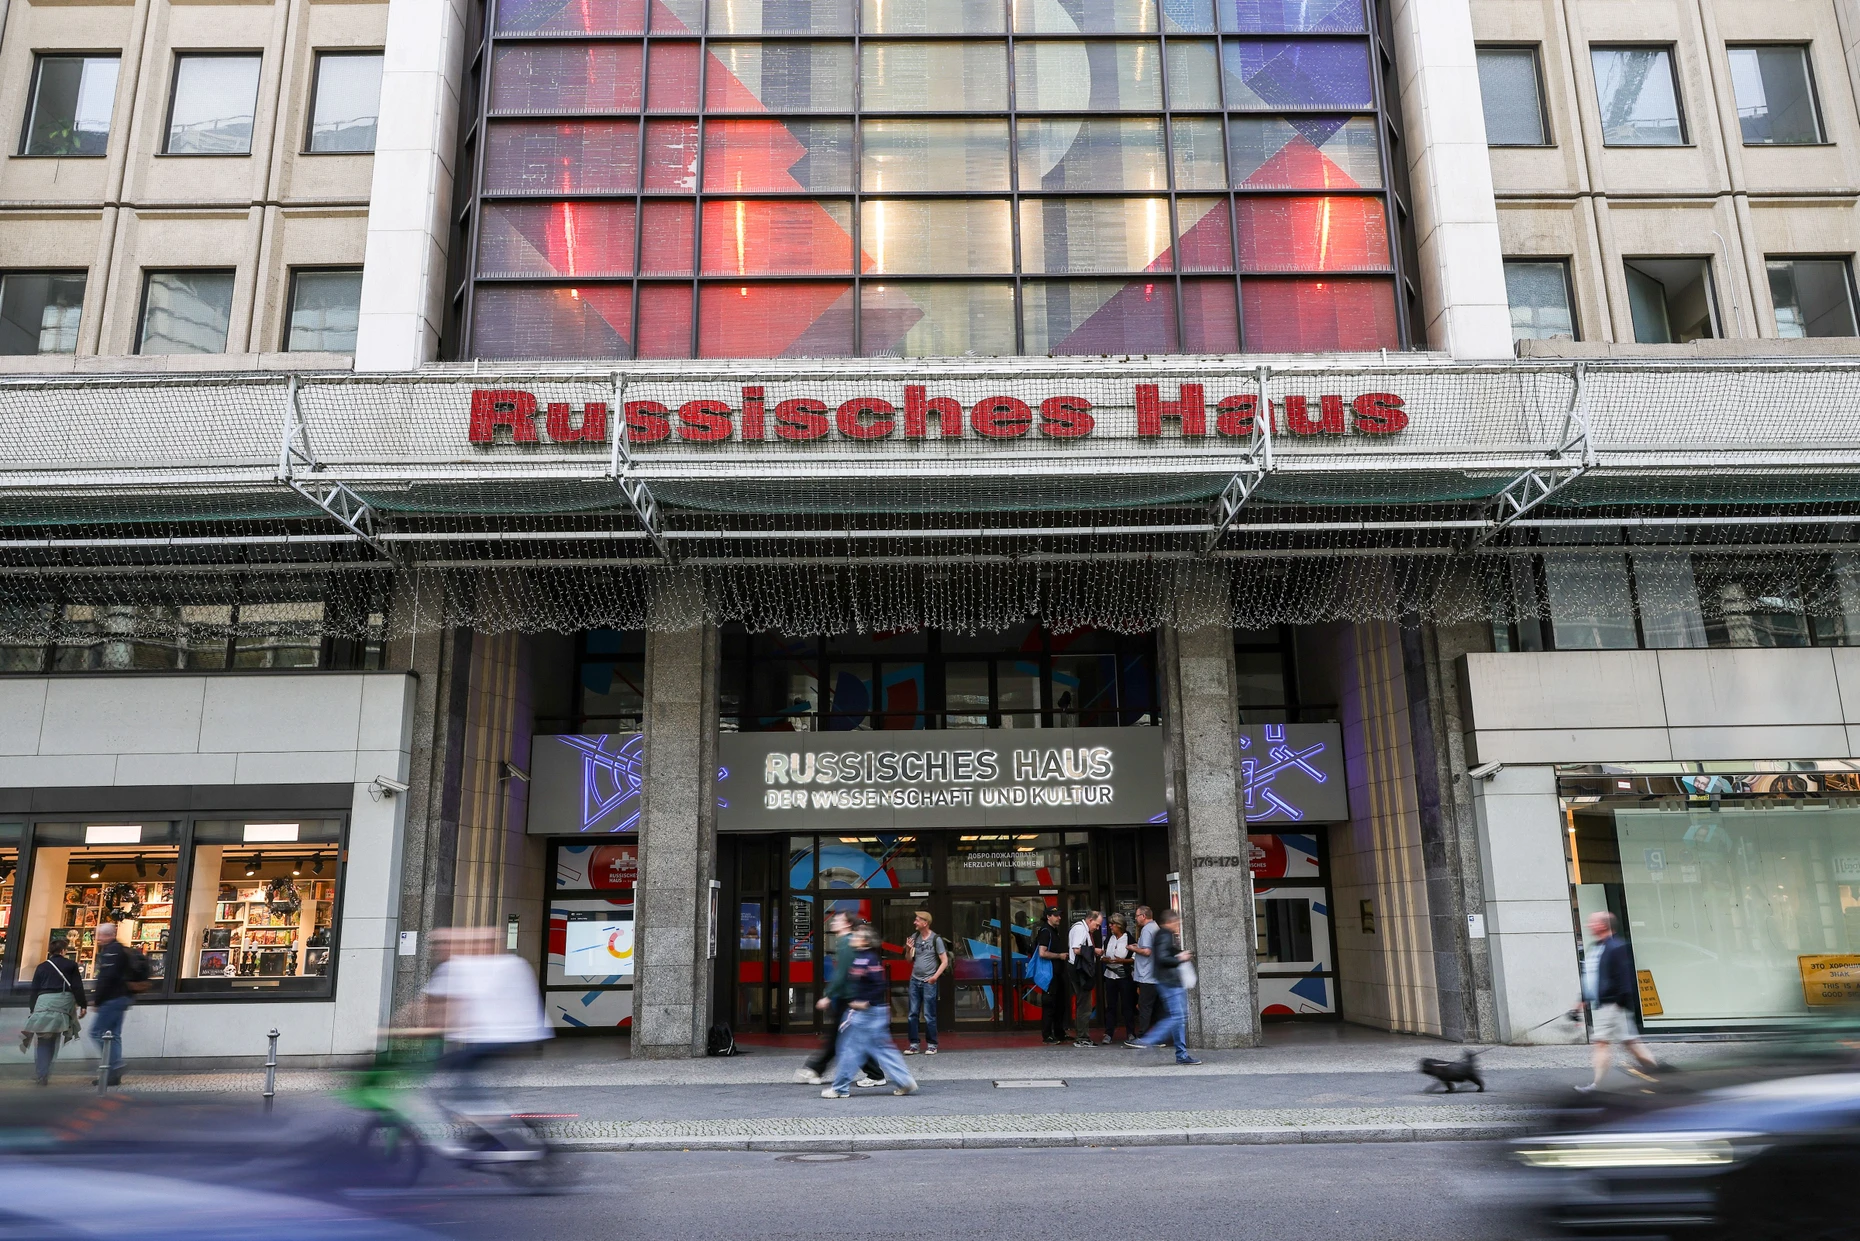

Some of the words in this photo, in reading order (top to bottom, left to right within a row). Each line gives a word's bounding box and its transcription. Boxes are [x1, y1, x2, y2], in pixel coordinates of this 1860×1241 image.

[468, 384, 1095, 443] Russisches
[1135, 383, 1409, 437] Haus
[766, 750, 998, 783] RUSSISCHES
[1014, 748, 1113, 779] HAUS
[765, 790, 806, 808] DER
[812, 788, 973, 809] WISSENSCHAFT
[982, 787, 1027, 806] UND
[1032, 785, 1113, 805] KULTUR
[967, 852, 990, 860] ДОБРО
[1192, 855, 1240, 868] 176-179
